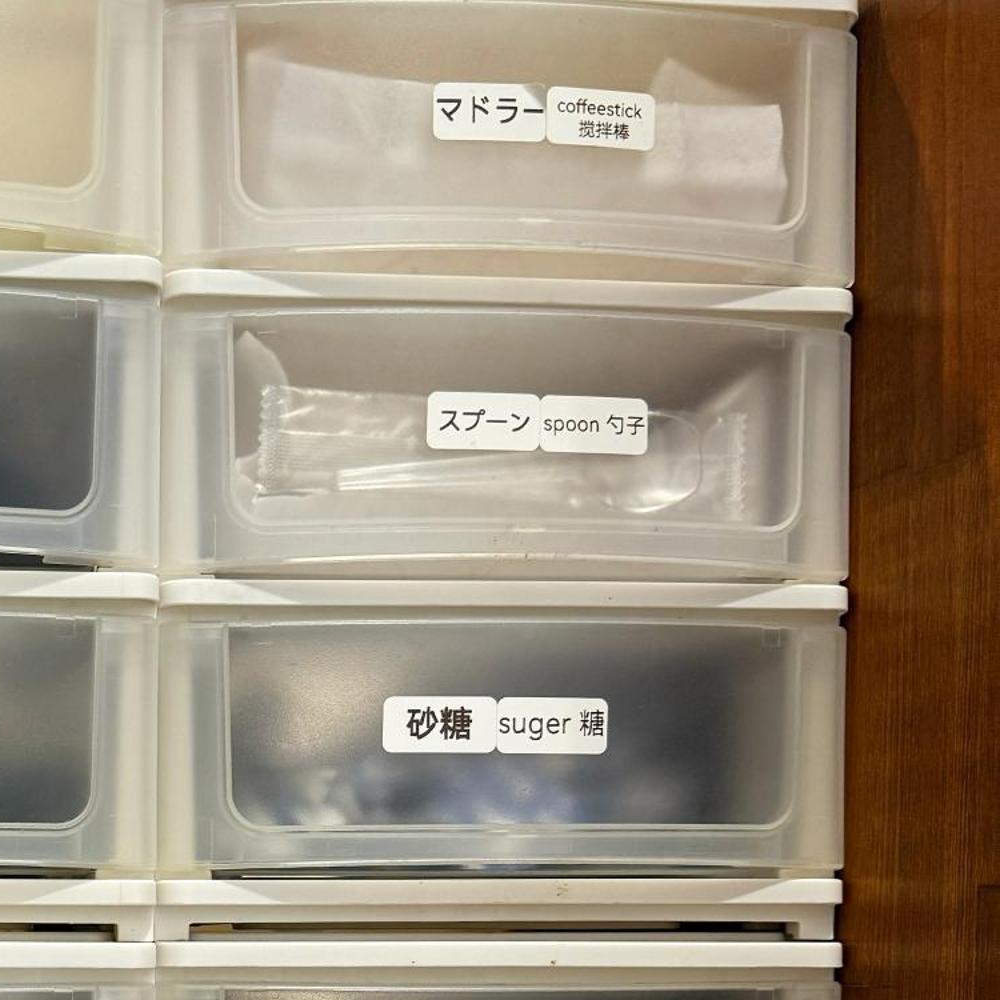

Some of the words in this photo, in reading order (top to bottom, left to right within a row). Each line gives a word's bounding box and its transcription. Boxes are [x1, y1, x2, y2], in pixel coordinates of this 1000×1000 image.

[436, 96, 546, 126] マドラー
[556, 97, 643, 121] coffeestick
[578, 119, 631, 141] 搅拌棒
[439, 408, 531, 433] スプーン
[543, 418, 600, 437] spoon
[605, 413, 646, 436] 勺子
[405, 705, 473, 741] 砂糖
[498, 716, 573, 741] suger
[579, 708, 605, 737] 糖
